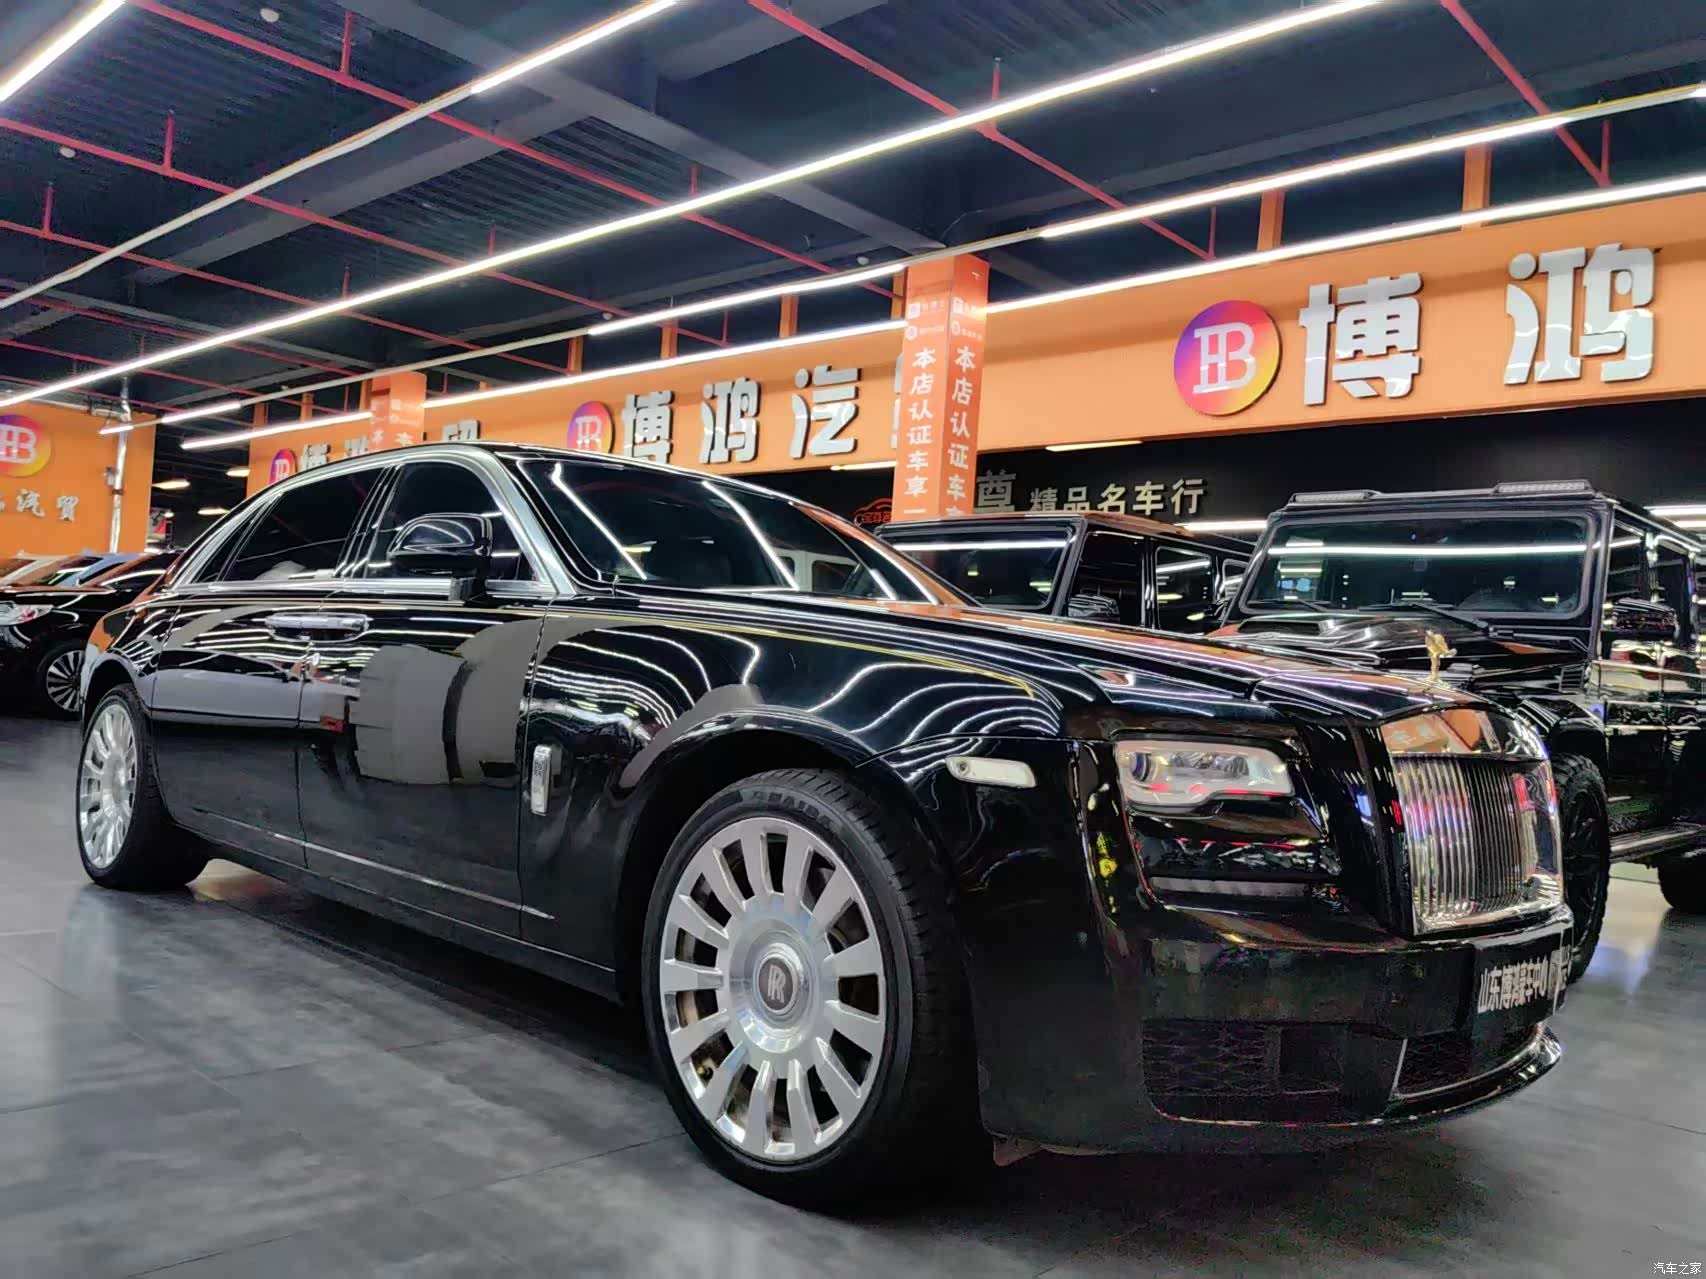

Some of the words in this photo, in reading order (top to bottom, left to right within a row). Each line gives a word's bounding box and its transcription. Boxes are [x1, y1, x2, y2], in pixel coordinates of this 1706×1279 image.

[622, 352, 903, 464] 博鸿汽
[1029, 478, 1205, 516] 精品名车行
